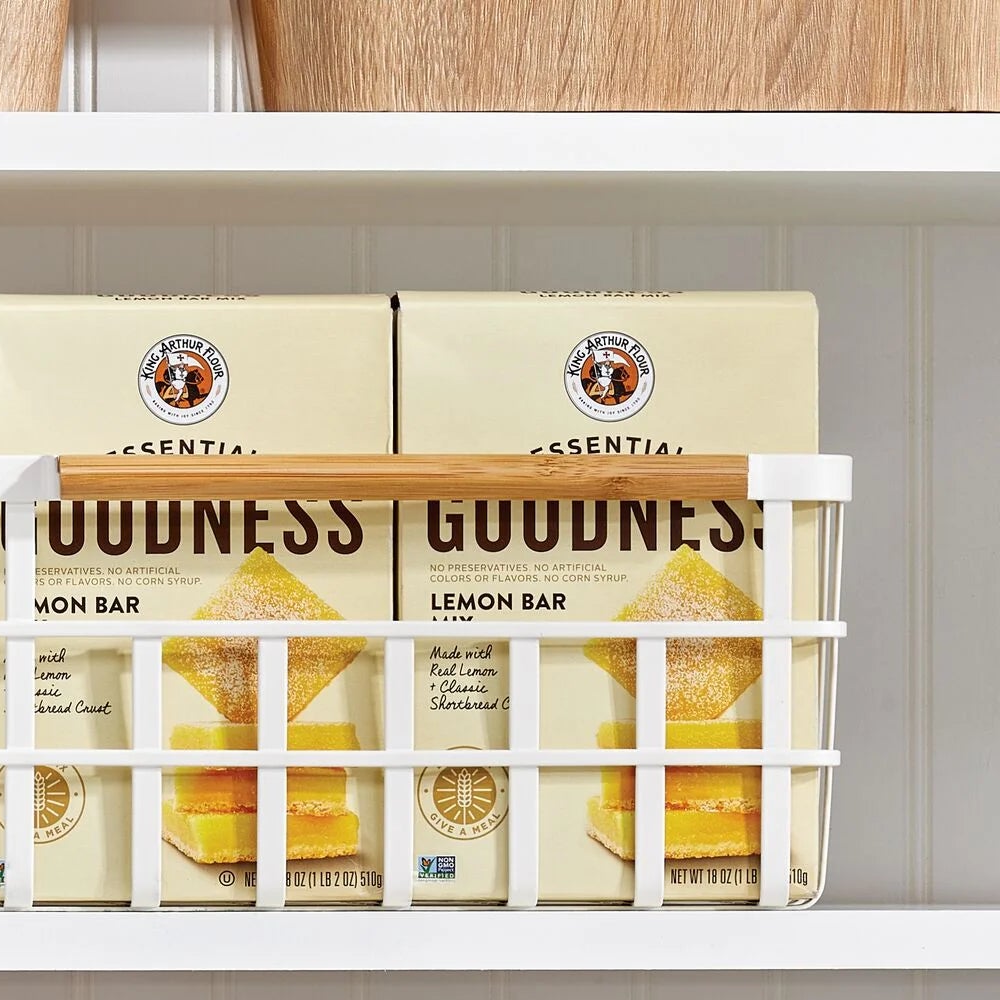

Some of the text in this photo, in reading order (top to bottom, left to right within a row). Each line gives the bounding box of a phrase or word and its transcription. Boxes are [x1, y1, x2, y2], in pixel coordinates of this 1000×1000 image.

[140, 338, 224, 381] KING ARTHUR FLOUR
[566, 335, 650, 378] KING ARTHUR FLOUR
[1, 501, 363, 556] OODNESS
[35, 566, 181, 576] ESERVATIVES. NO ARTIFICIAL
[430, 563, 607, 572] NO PRESERVATIVES. NO ARTIFICIAL
[48, 577, 63, 586] OR
[66, 577, 115, 586] FLAVORS.
[118, 577, 133, 585] NO
[136, 577, 164, 585] CORN
[167, 576, 203, 586] SYRUP.
[430, 574, 629, 583] COLORS OR FLAVORS. NO CORN SYRUP.
[34, 596, 140, 614] MON BAR
[431, 593, 566, 611] LEMON BAR
[39, 648, 67, 663] with
[429, 644, 493, 660] Made with
[34, 666, 71, 681] Lemon
[430, 663, 498, 677] Real Lemon
[35, 684, 62, 697] ssic
[440, 679, 489, 693] Classic
[75, 700, 112, 715] Crust
[430, 694, 499, 710] Shortbread
[45, 815, 74, 839] MEAL
[430, 812, 501, 836] GIVE A MEAL
[244, 871, 382, 888] NE OZ (1 LB 2 OZ) 510g
[670, 868, 688, 884] NET
[689, 868, 704, 884] WT
[707, 868, 718, 884] 18
[720, 868, 732, 884] OZ
[734, 868, 742, 886] (1
[746, 868, 758, 884] LB
